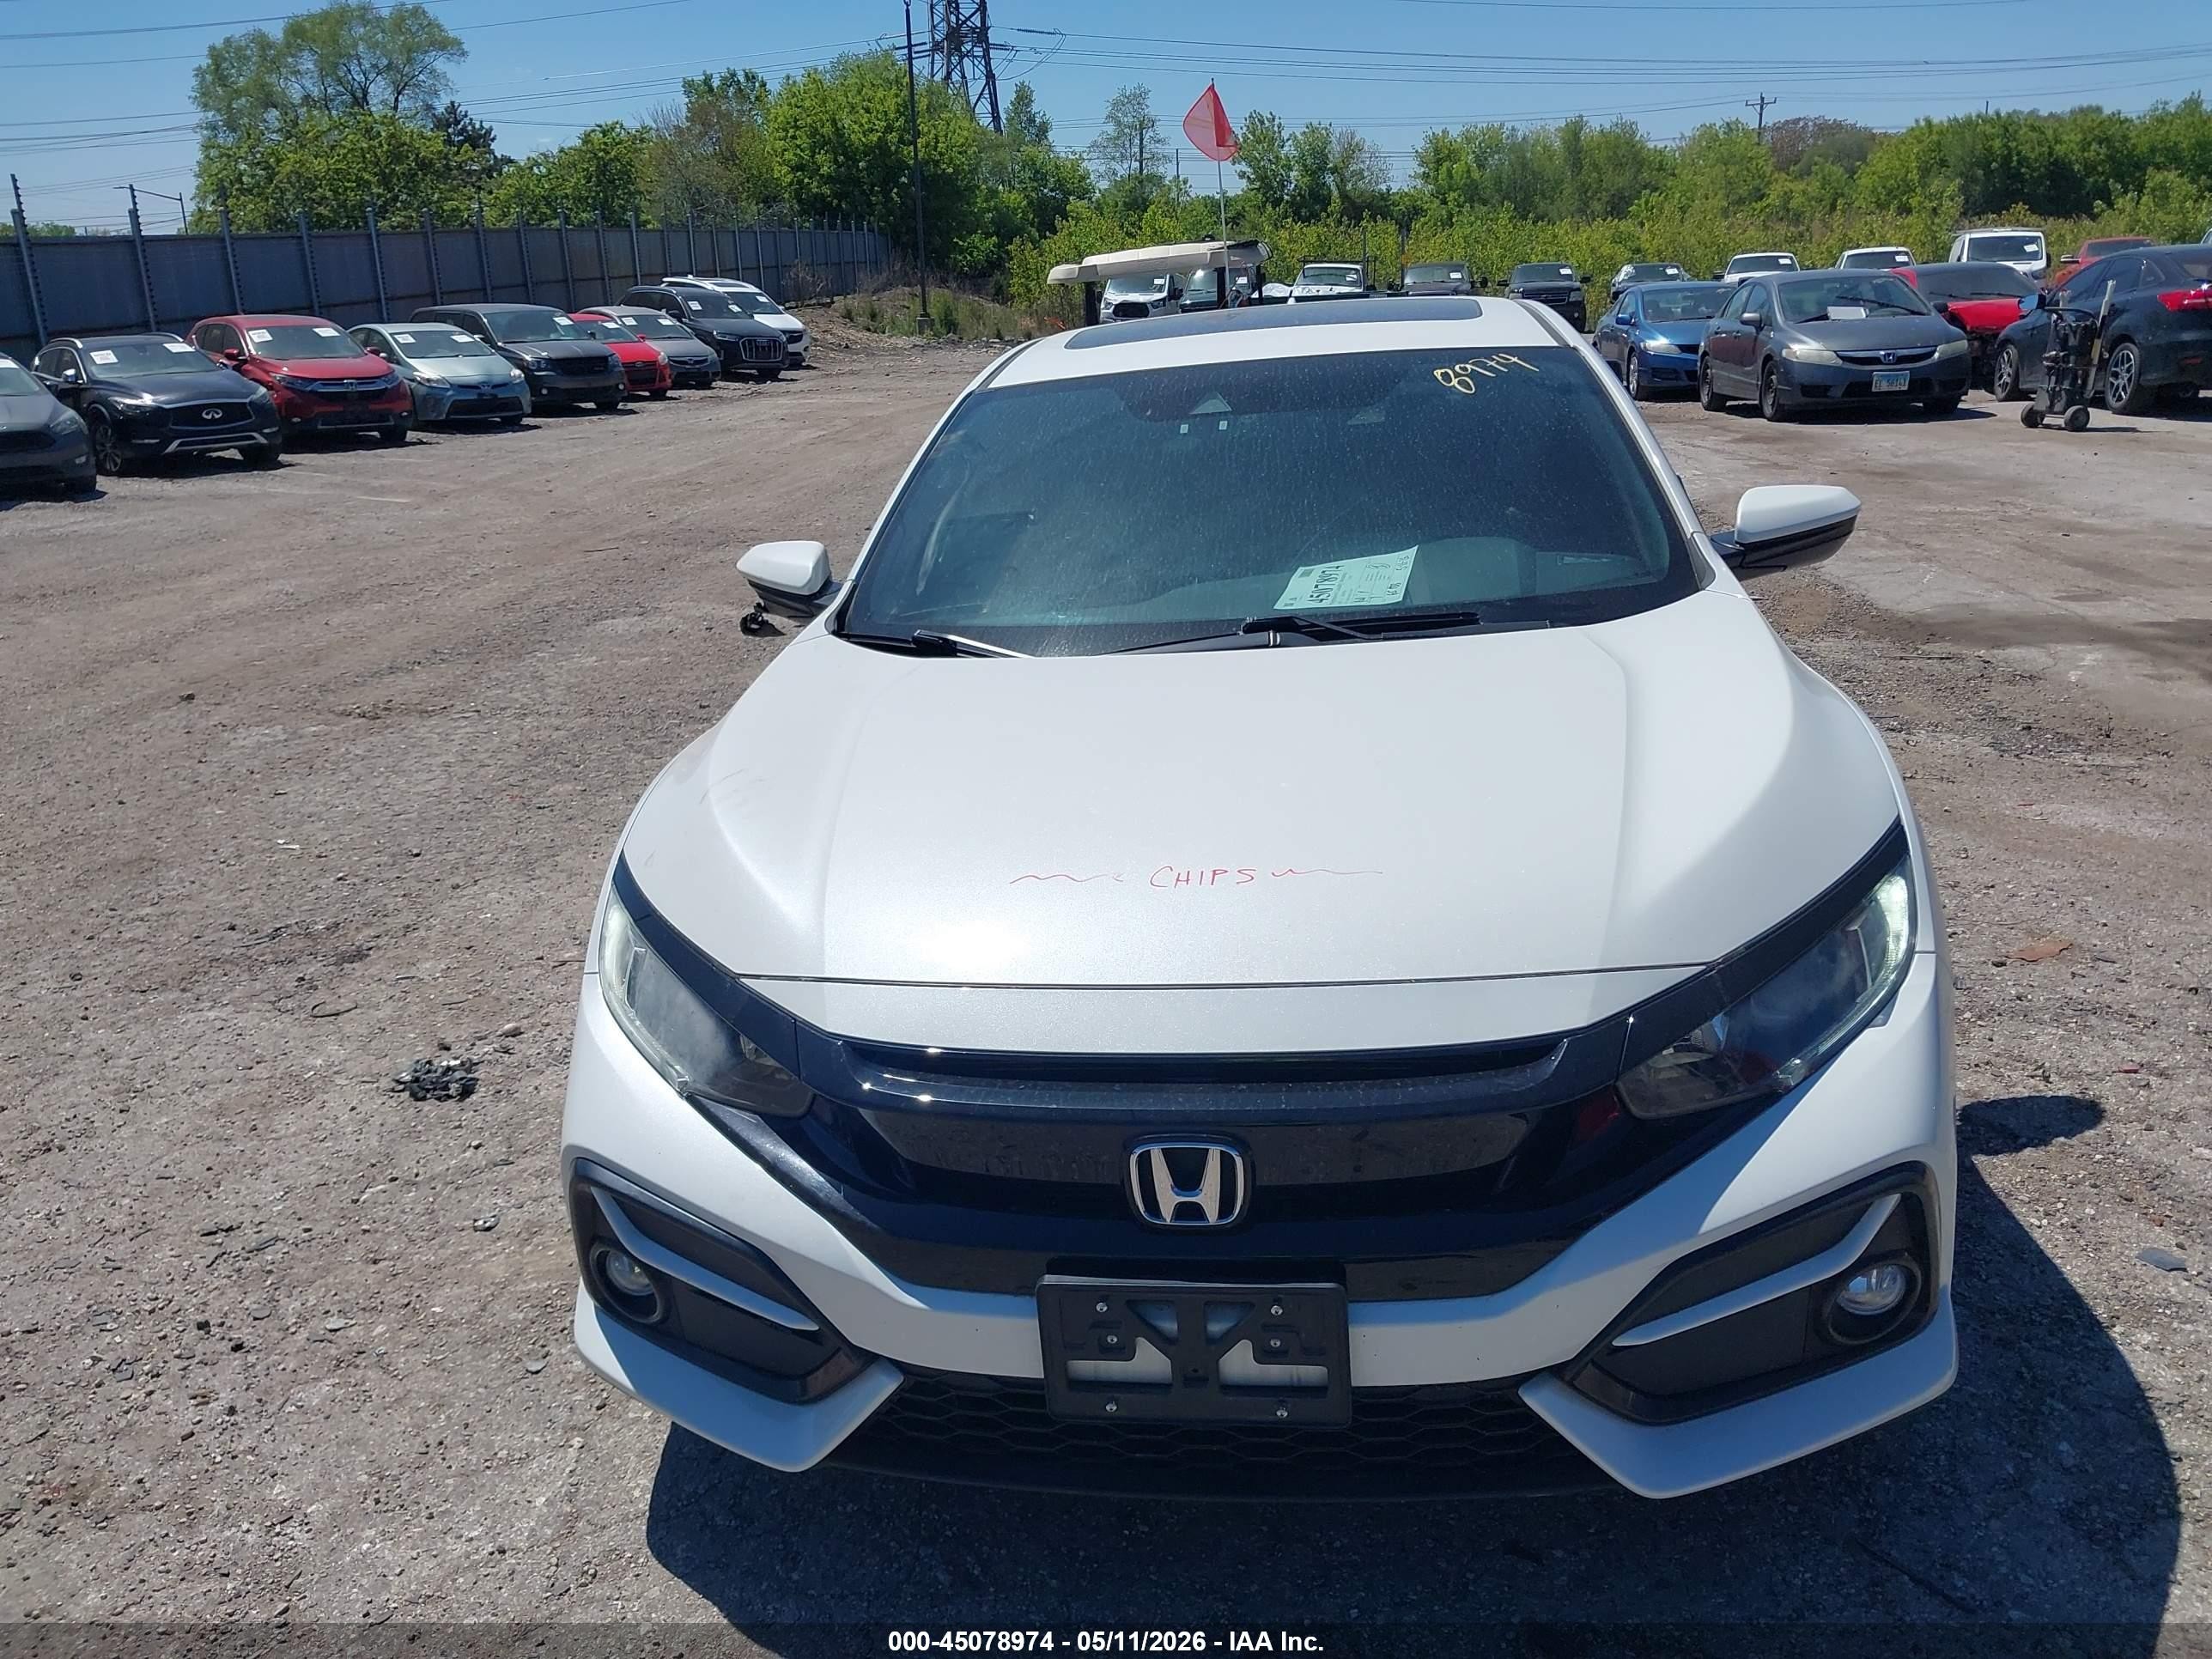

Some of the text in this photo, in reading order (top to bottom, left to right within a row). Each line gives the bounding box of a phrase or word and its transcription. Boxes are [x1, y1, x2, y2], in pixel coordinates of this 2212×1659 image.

[1433, 353, 1540, 394] 8974
[1306, 565, 1345, 603] 45078974
[1150, 866, 1256, 889] CHIPS
